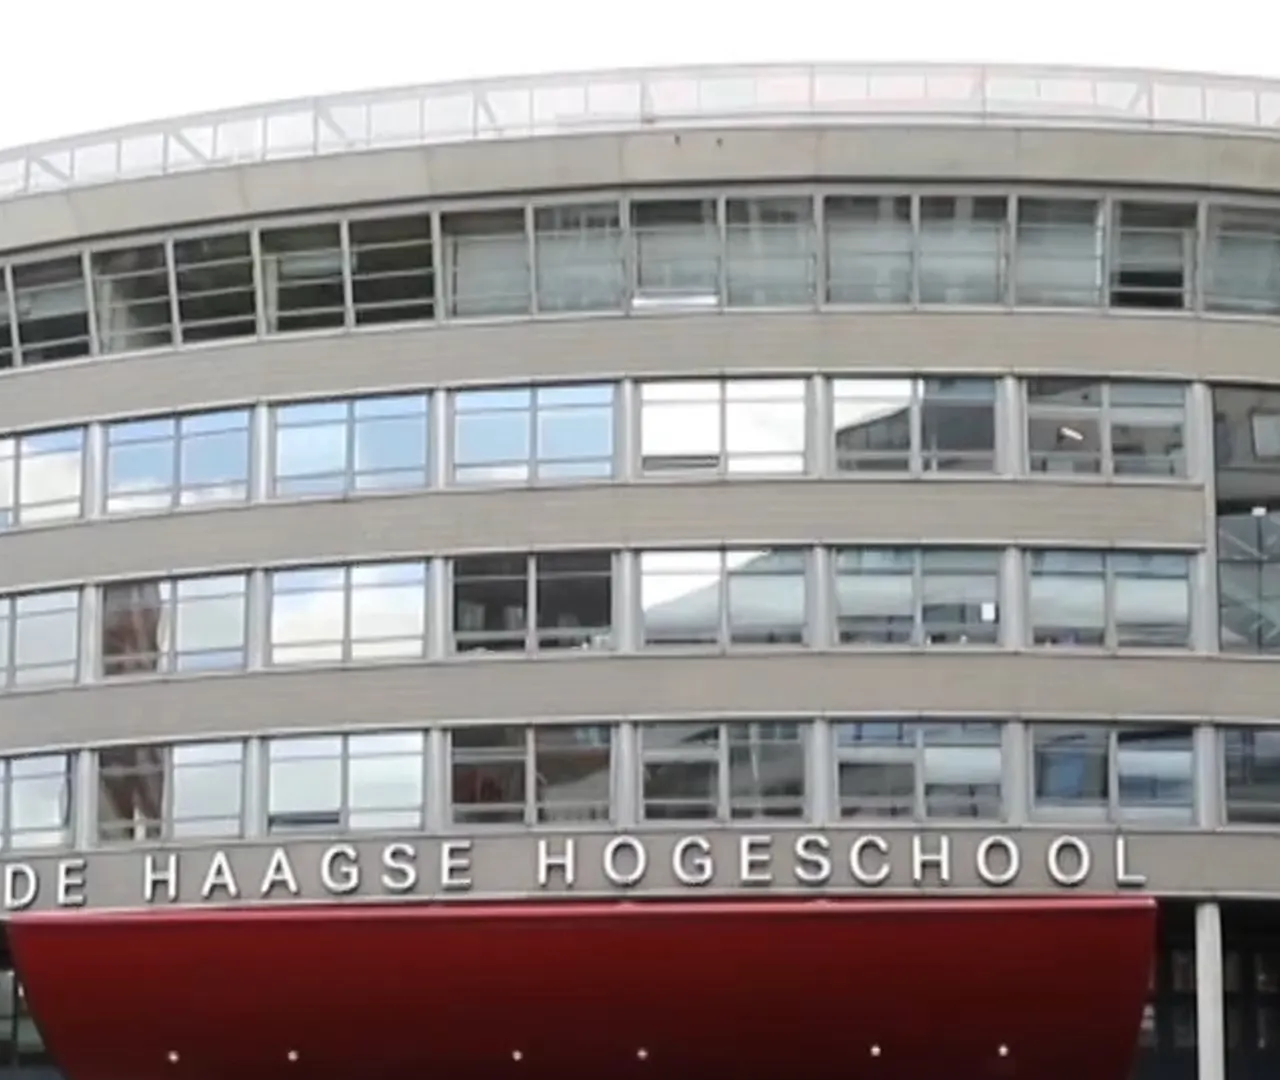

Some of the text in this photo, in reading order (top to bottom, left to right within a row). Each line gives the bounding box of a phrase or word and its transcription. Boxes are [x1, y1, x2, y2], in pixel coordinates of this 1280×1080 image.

[3, 833, 1147, 911] DE HAAGSE HOGESCHOOL
